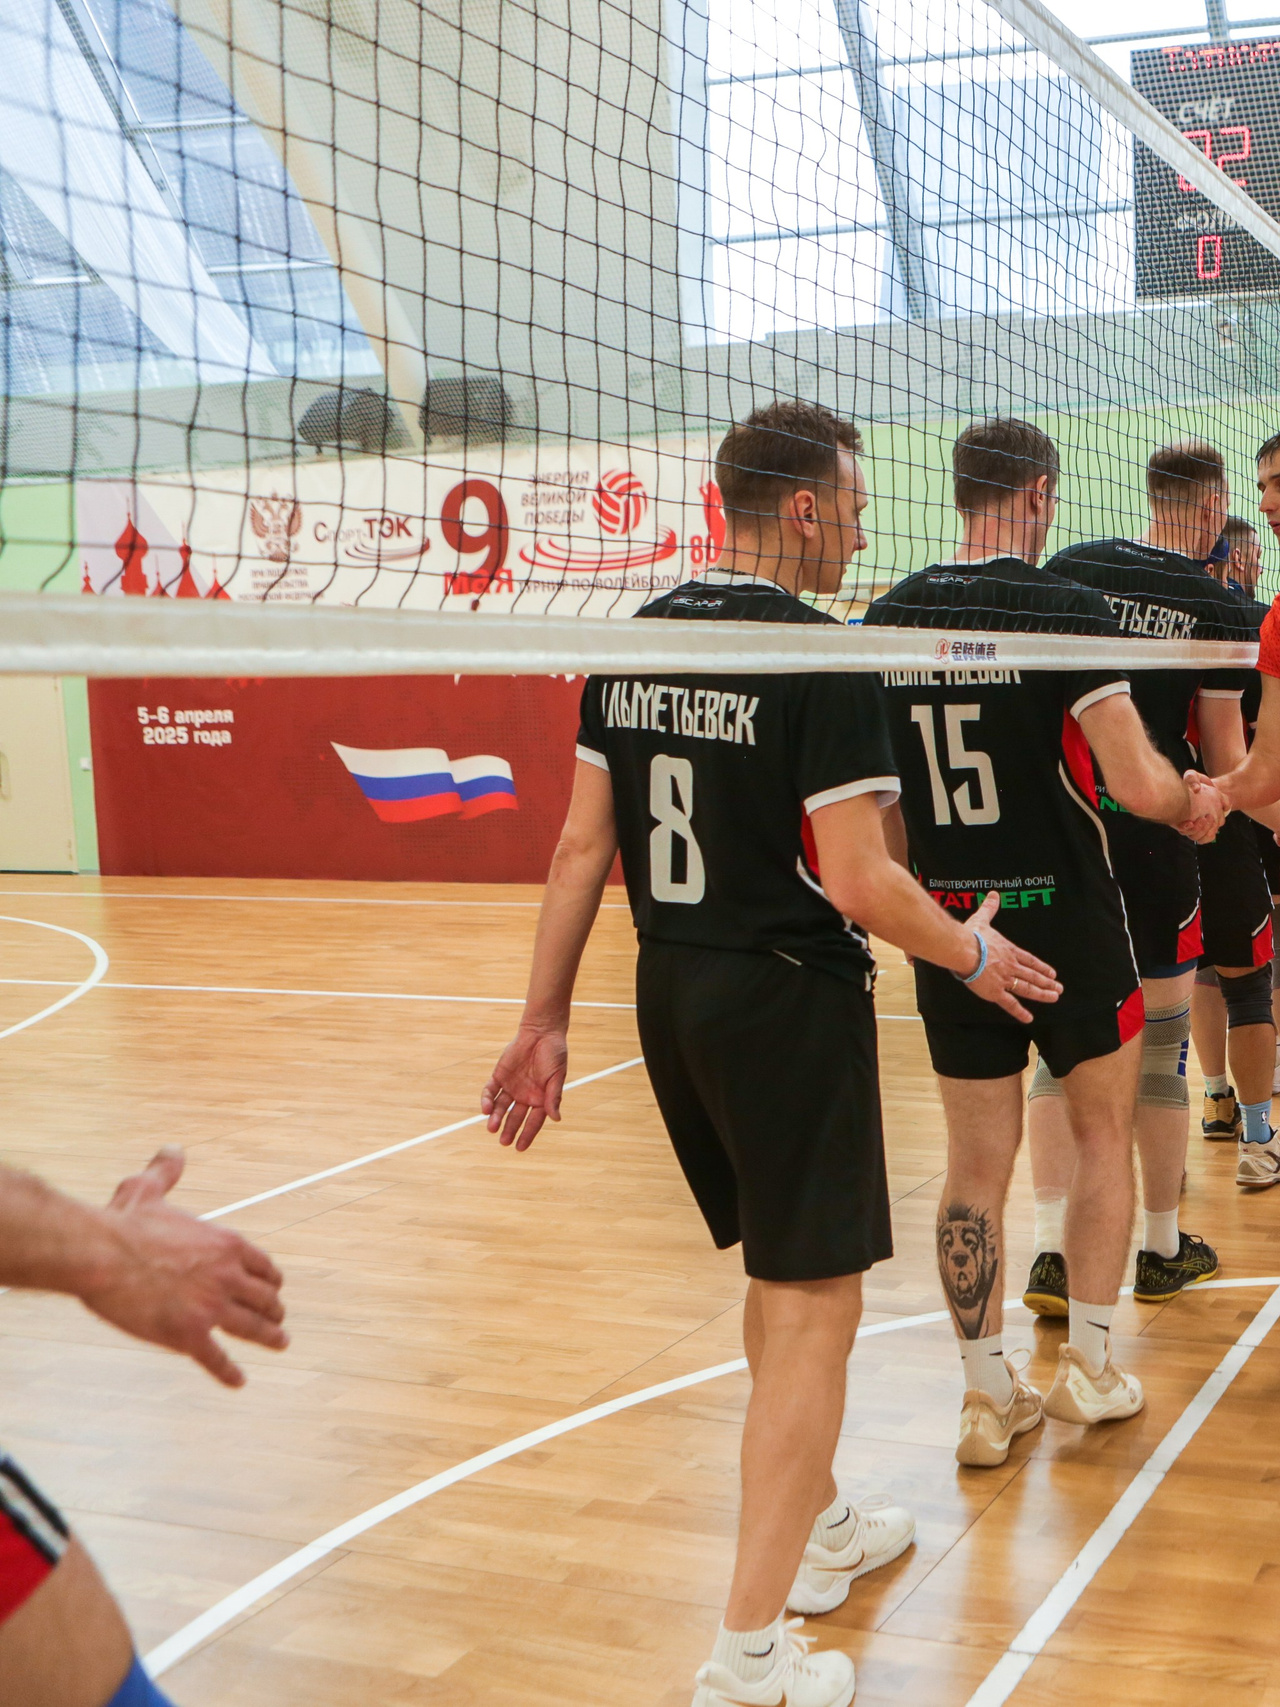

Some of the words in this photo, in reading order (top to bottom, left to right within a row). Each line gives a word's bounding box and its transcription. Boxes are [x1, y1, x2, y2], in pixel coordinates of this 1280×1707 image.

[1197, 235, 1222, 279] 0
[521, 489, 587, 507] ВЕЛИКОЙ
[441, 479, 509, 576] 9
[525, 509, 585, 526] ПОБЕДЫ
[571, 578, 592, 592] ПО
[596, 573, 681, 591] ВОЛЕЙБОЛУ
[137, 706, 170, 724] 5-6
[174, 709, 234, 728] апреля
[602, 680, 760, 746] ЛЬМЕТЬЕВСК
[143, 726, 189, 745] 2025
[193, 730, 232, 746] года
[911, 704, 1000, 826] 15
[650, 754, 705, 904] 8
[929, 877, 1022, 889] БЛАГОТВОРИТЕЛЬНЫЙ
[1024, 875, 1055, 888] ФОНД
